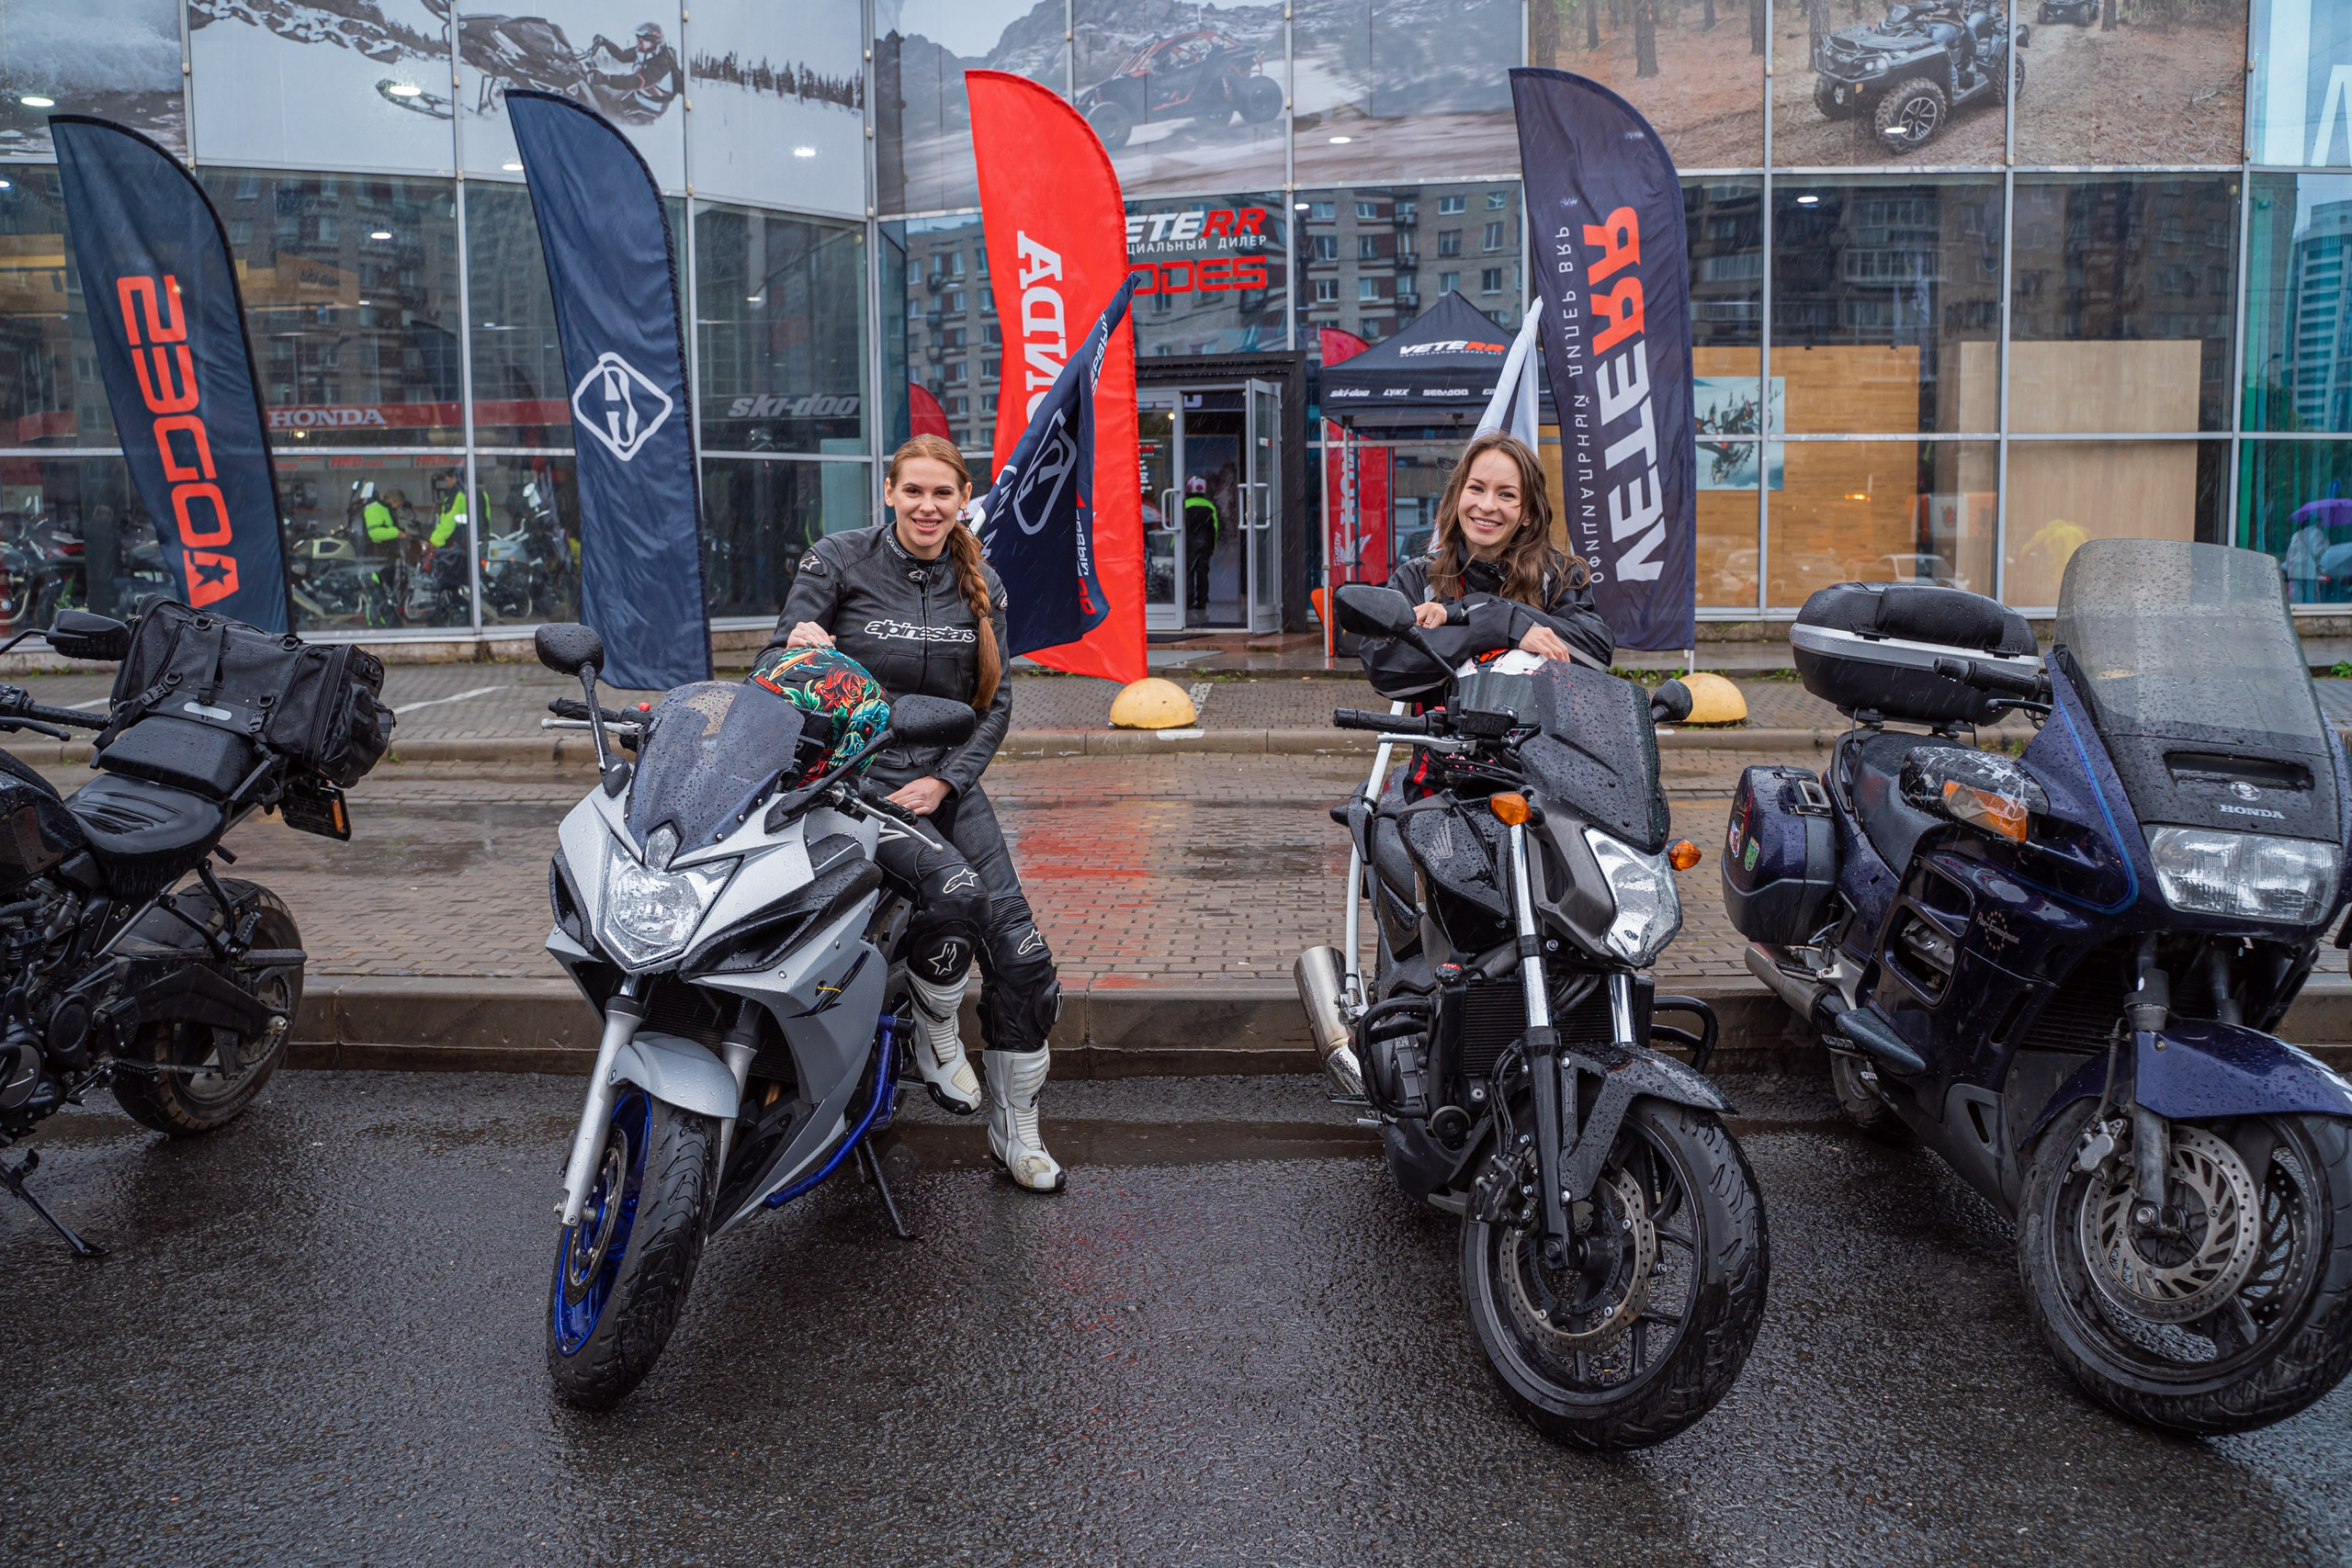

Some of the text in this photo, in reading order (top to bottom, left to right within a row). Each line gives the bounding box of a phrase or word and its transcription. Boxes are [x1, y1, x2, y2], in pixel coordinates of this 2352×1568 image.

[1126, 208, 1266, 243] ETERR
[1127, 235, 1267, 256] ЦИАЛЬНЫЙ ДИЛЕР
[1128, 255, 1267, 297] ODES
[1399, 340, 1506, 355] VETERR
[1330, 389, 1370, 397] ski-doo
[1383, 389, 1410, 397] LYNX
[727, 392, 860, 418] ski-doo
[268, 409, 387, 427] HONDA
[864, 618, 977, 643] alpinestars
[2219, 804, 2286, 819] HONDA
